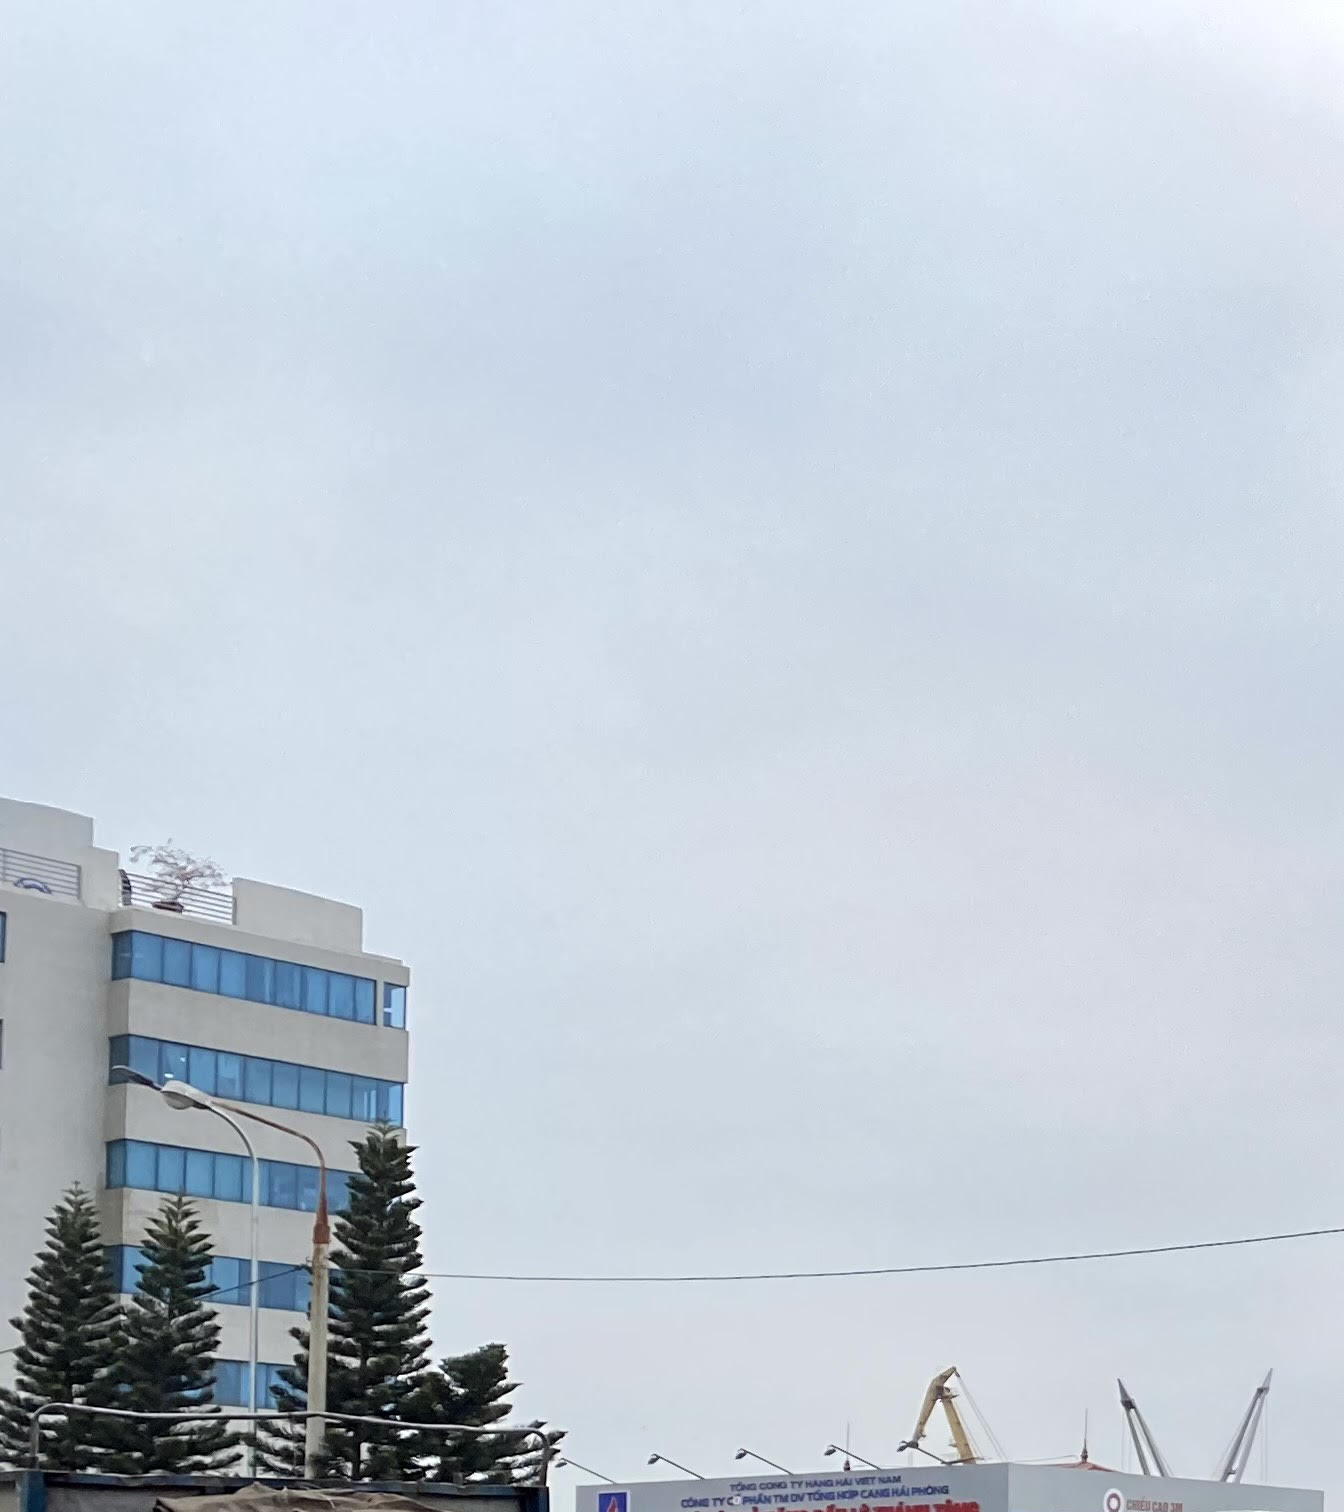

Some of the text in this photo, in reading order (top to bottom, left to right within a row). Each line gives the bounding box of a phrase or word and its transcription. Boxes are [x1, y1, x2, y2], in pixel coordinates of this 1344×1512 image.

[791, 1480, 804, 1490] TY
[879, 1475, 901, 1484] NAM
[713, 1496, 726, 1507] TY
[1152, 1502, 1169, 1512] CAO
